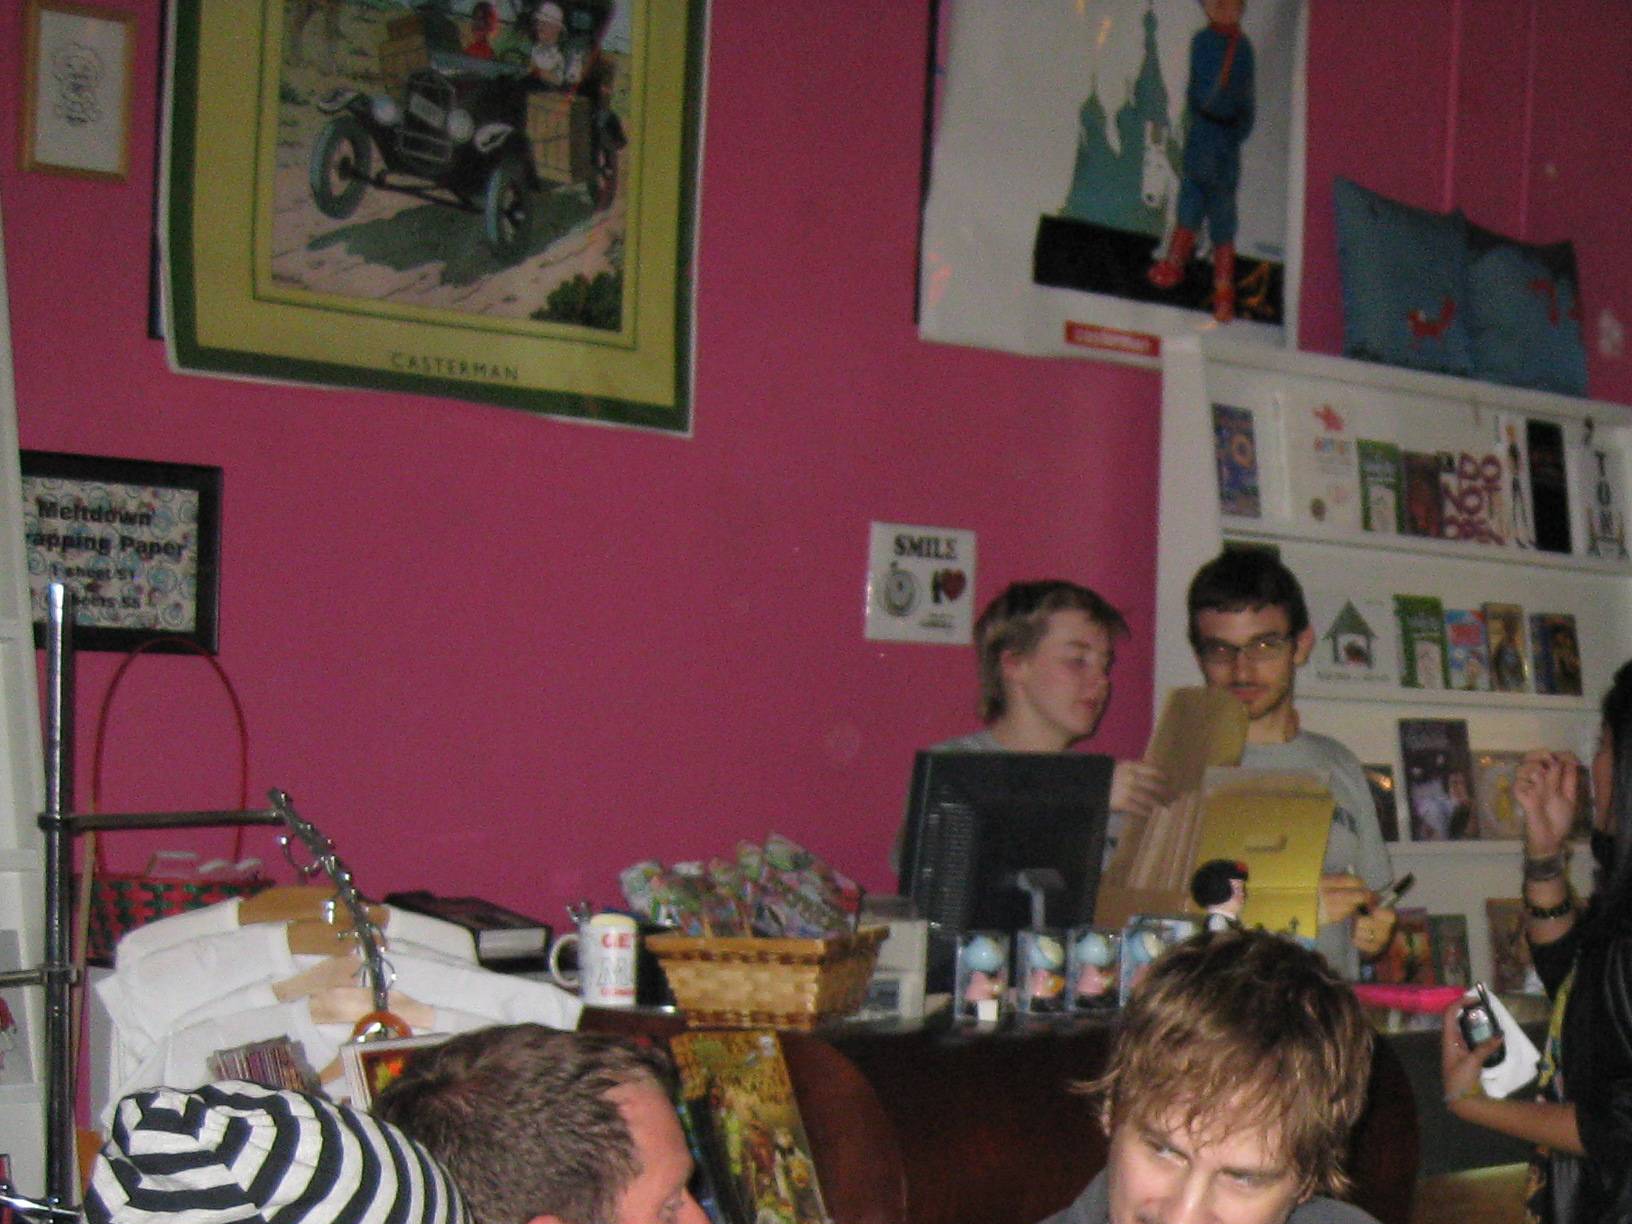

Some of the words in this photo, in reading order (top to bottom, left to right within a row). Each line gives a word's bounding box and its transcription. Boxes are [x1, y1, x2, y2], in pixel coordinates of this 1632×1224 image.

[391, 350, 518, 380] CASTERMAN
[38, 500, 154, 526] Meltdown
[27, 530, 112, 556] rapping
[120, 534, 187, 564] Paper
[894, 533, 958, 559] SMILE
